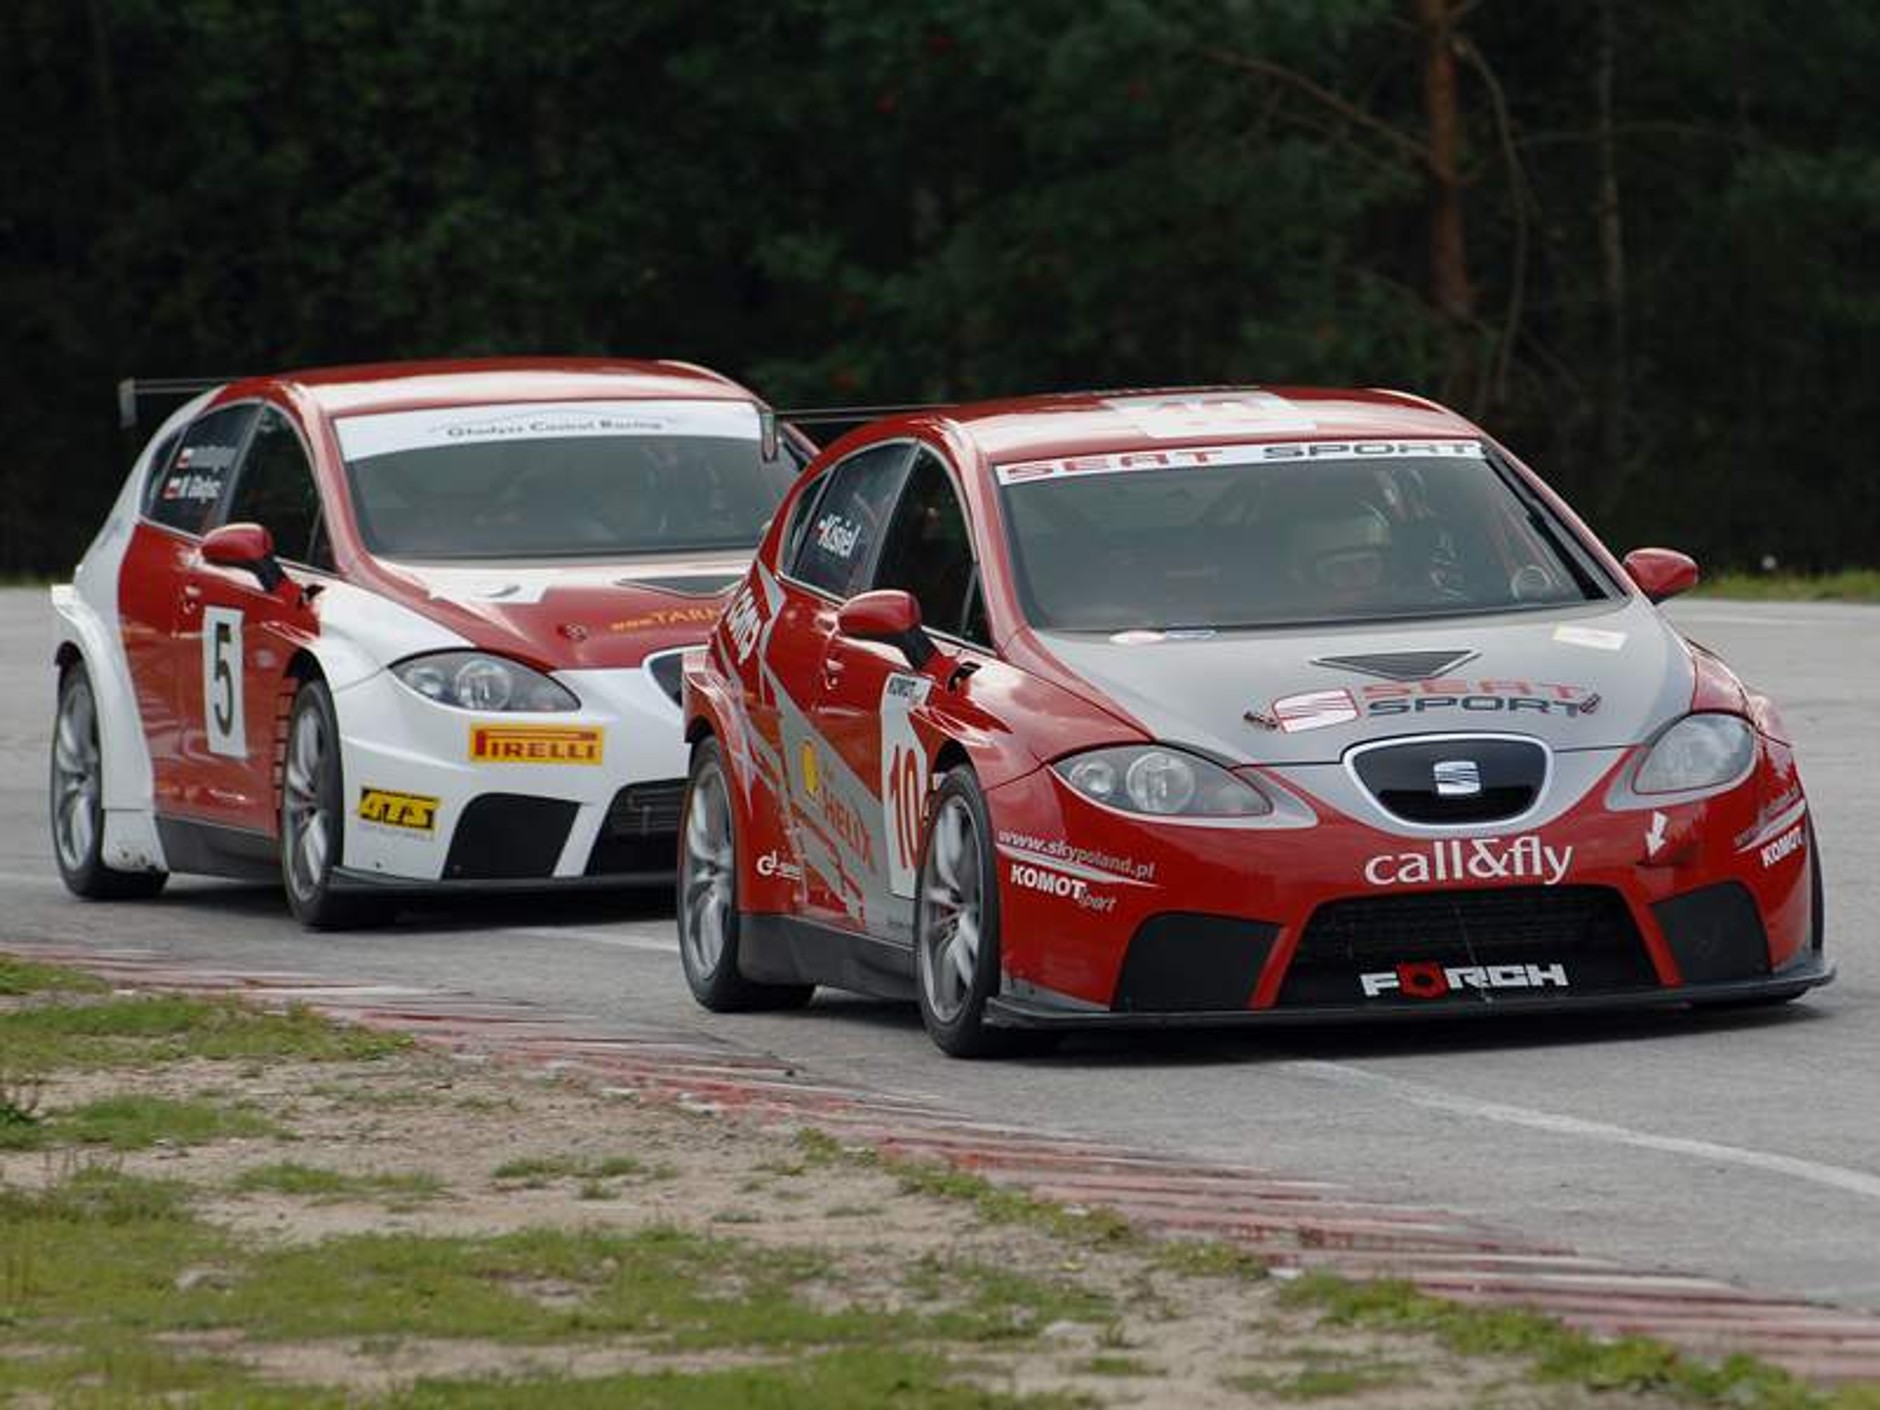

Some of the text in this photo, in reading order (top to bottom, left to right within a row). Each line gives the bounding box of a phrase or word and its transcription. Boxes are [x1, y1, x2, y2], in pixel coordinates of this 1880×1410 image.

[1006, 442, 1479, 480] SEAT SPORT
[214, 622, 234, 738] 5
[1363, 678, 1583, 699] SEAT
[1368, 696, 1580, 718] SPORT
[473, 728, 598, 759] PIRELLI
[888, 743, 920, 873] 10
[1364, 835, 1574, 886] call&fly
[1010, 864, 1088, 900] KOMOT
